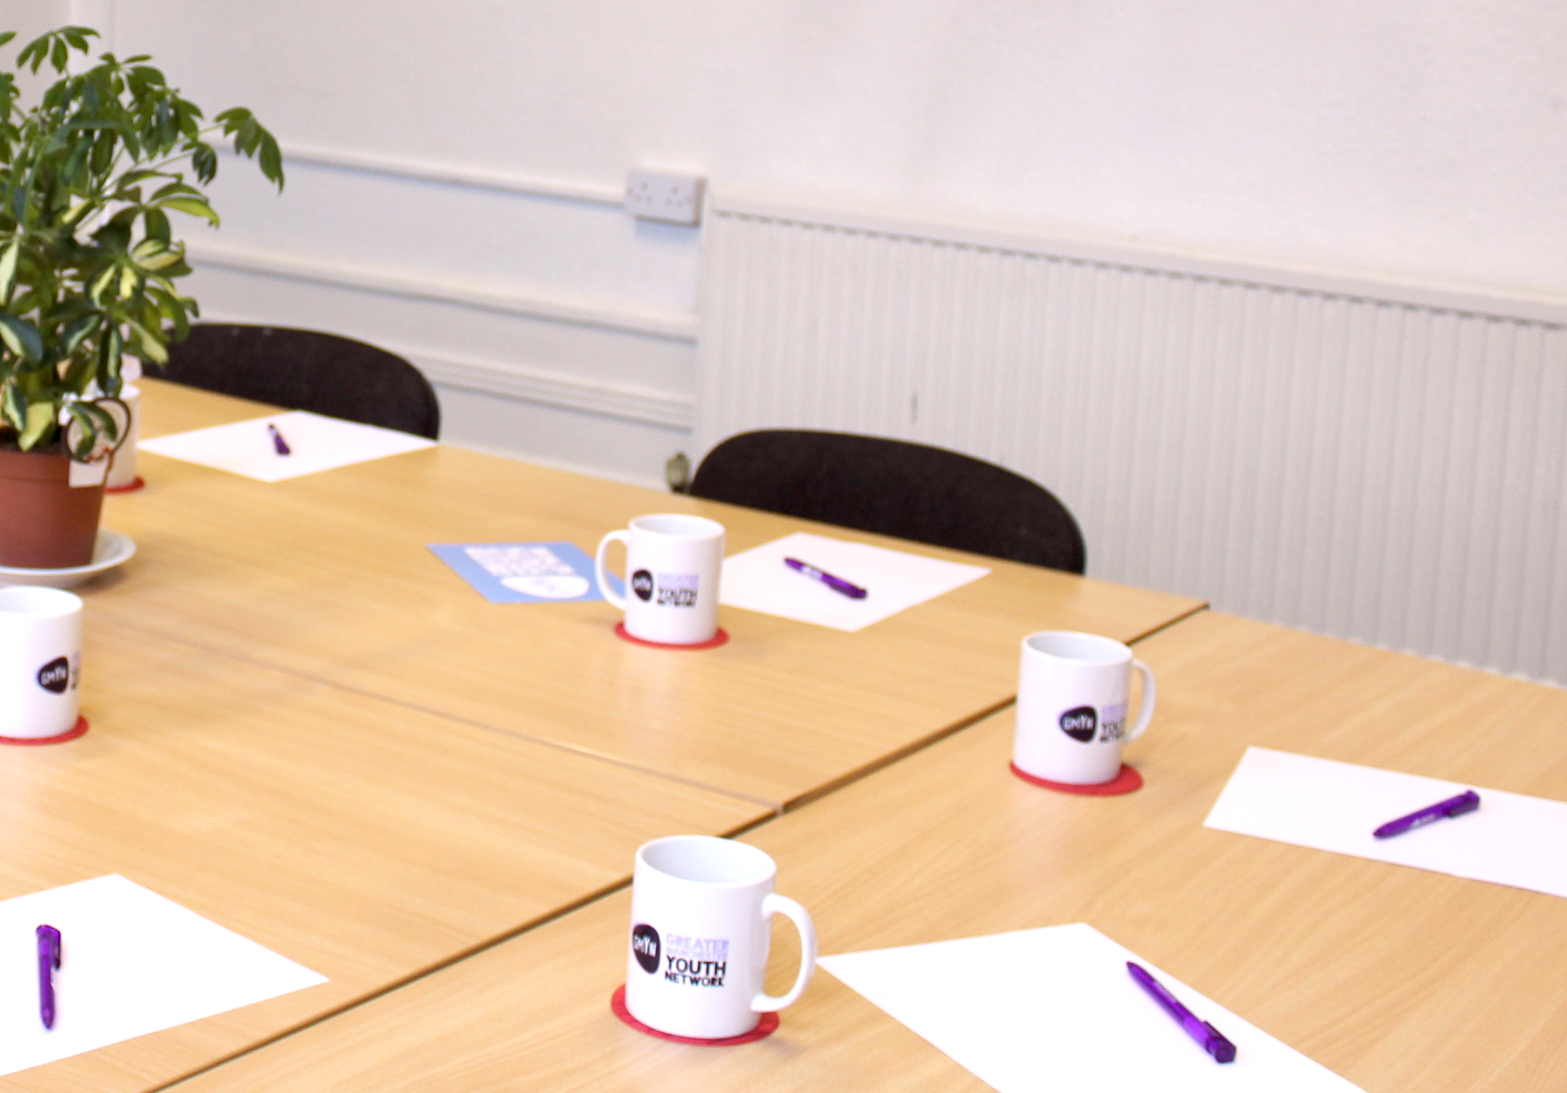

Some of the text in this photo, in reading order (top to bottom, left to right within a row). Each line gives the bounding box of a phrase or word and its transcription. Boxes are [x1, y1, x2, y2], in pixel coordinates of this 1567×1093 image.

[666, 933, 729, 950] GREATER
[666, 955, 727, 976] YOUTH
[664, 971, 725, 987] NETWORK
